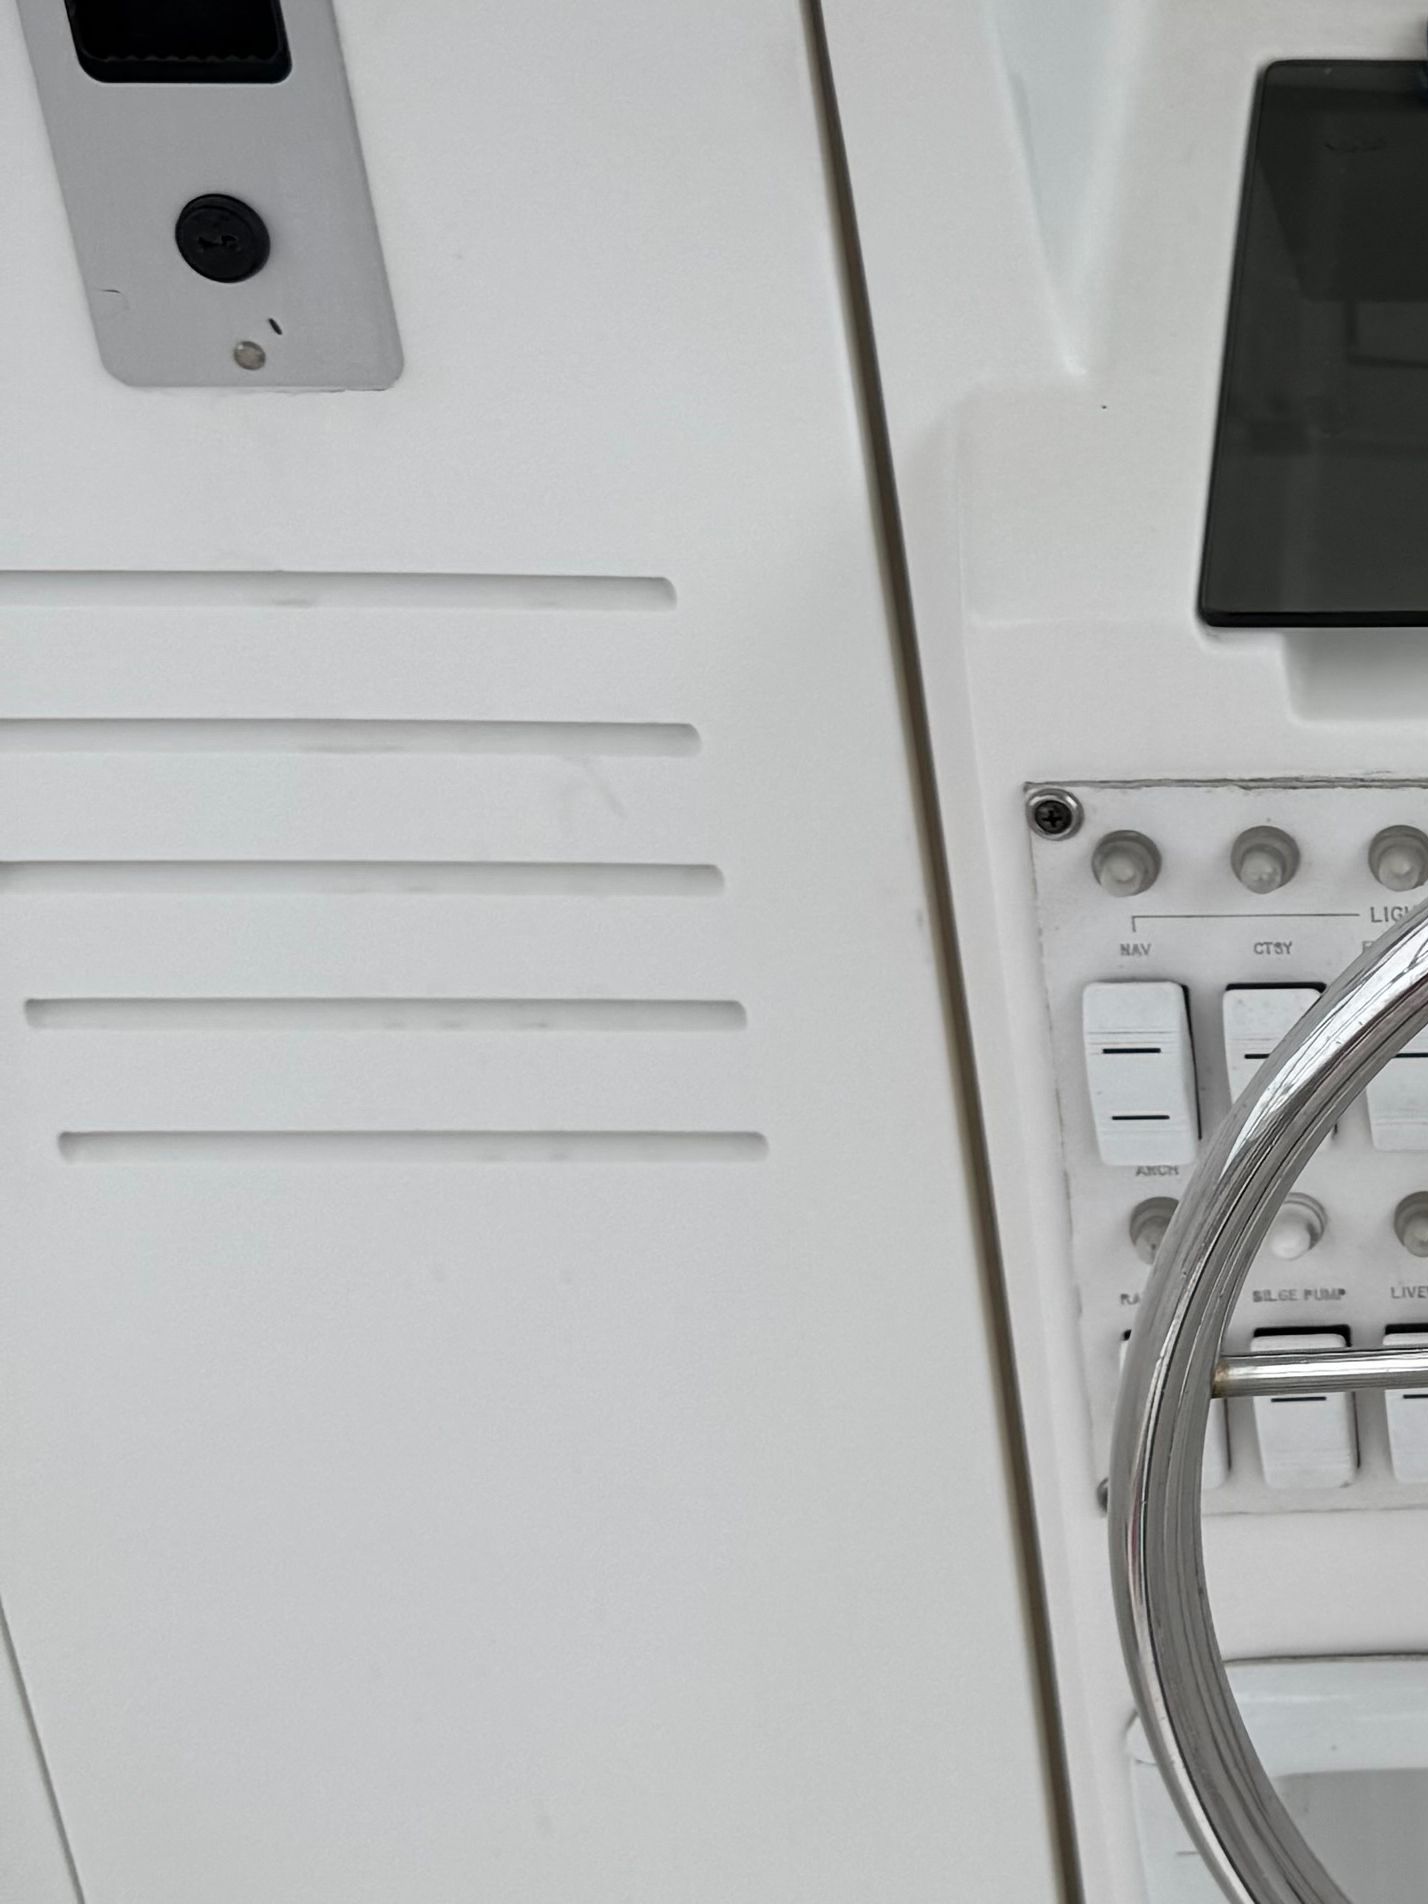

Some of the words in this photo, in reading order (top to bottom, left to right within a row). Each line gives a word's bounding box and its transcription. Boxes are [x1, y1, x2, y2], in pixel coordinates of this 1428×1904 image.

[1120, 943, 1151, 956] NAV
[1252, 1289, 1299, 1302] BILGE
[1303, 1287, 1346, 1301] PUMP
